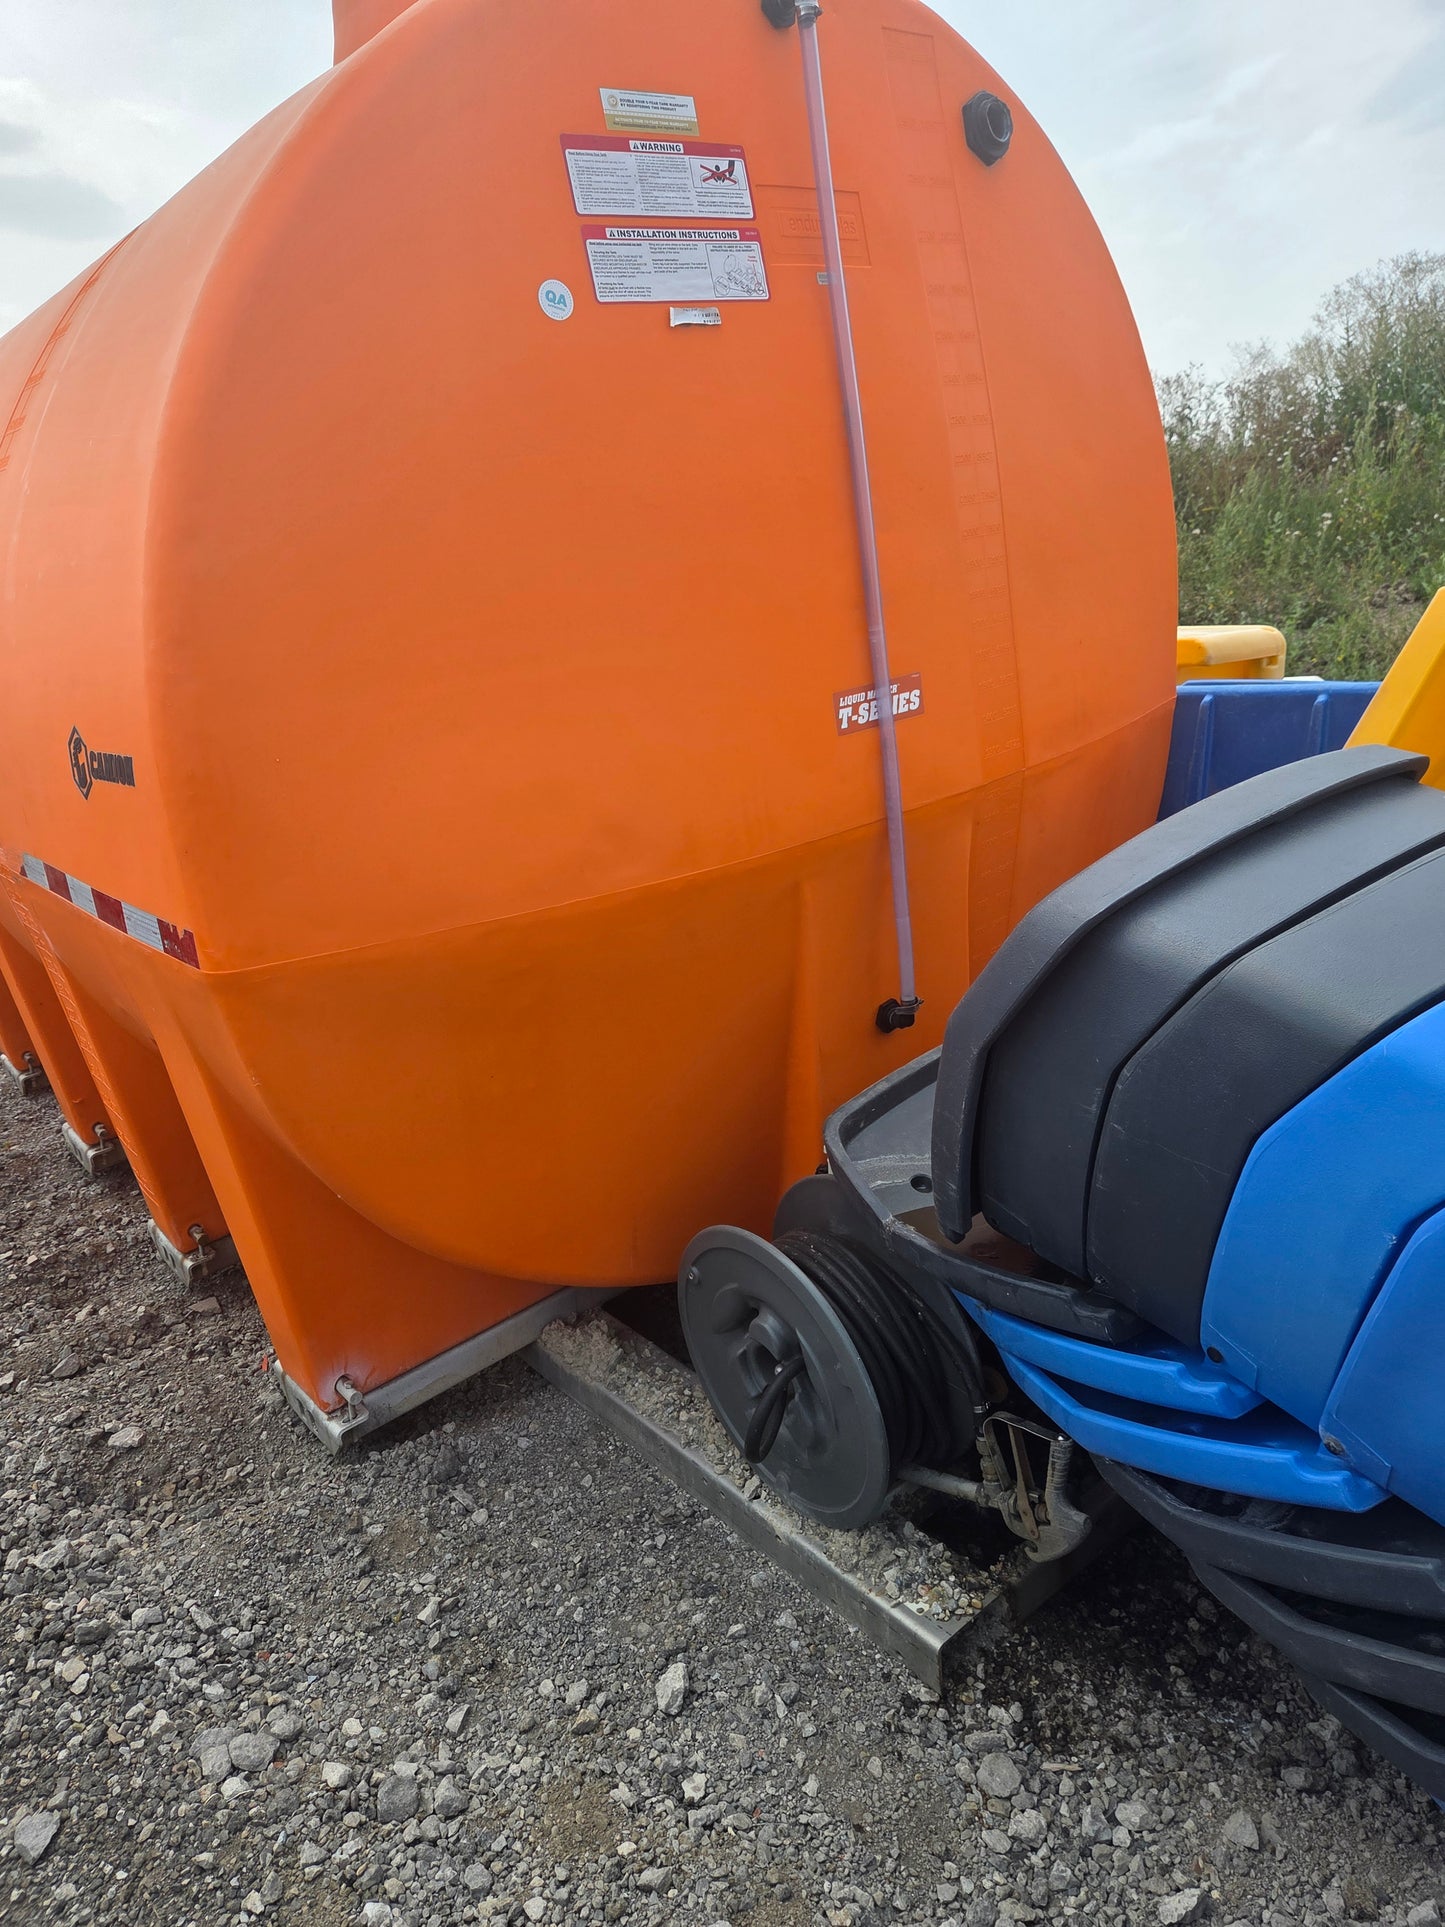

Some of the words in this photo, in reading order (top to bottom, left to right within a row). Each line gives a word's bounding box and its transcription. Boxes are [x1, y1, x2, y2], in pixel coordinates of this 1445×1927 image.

[639, 141, 682, 152] WARNING
[617, 230, 677, 239] INSTALLATION
[679, 230, 738, 239] INSTRUCTIONS
[545, 290, 568, 307] QA
[839, 692, 866, 707] LIQUID
[838, 689, 921, 729] T-SEIES
